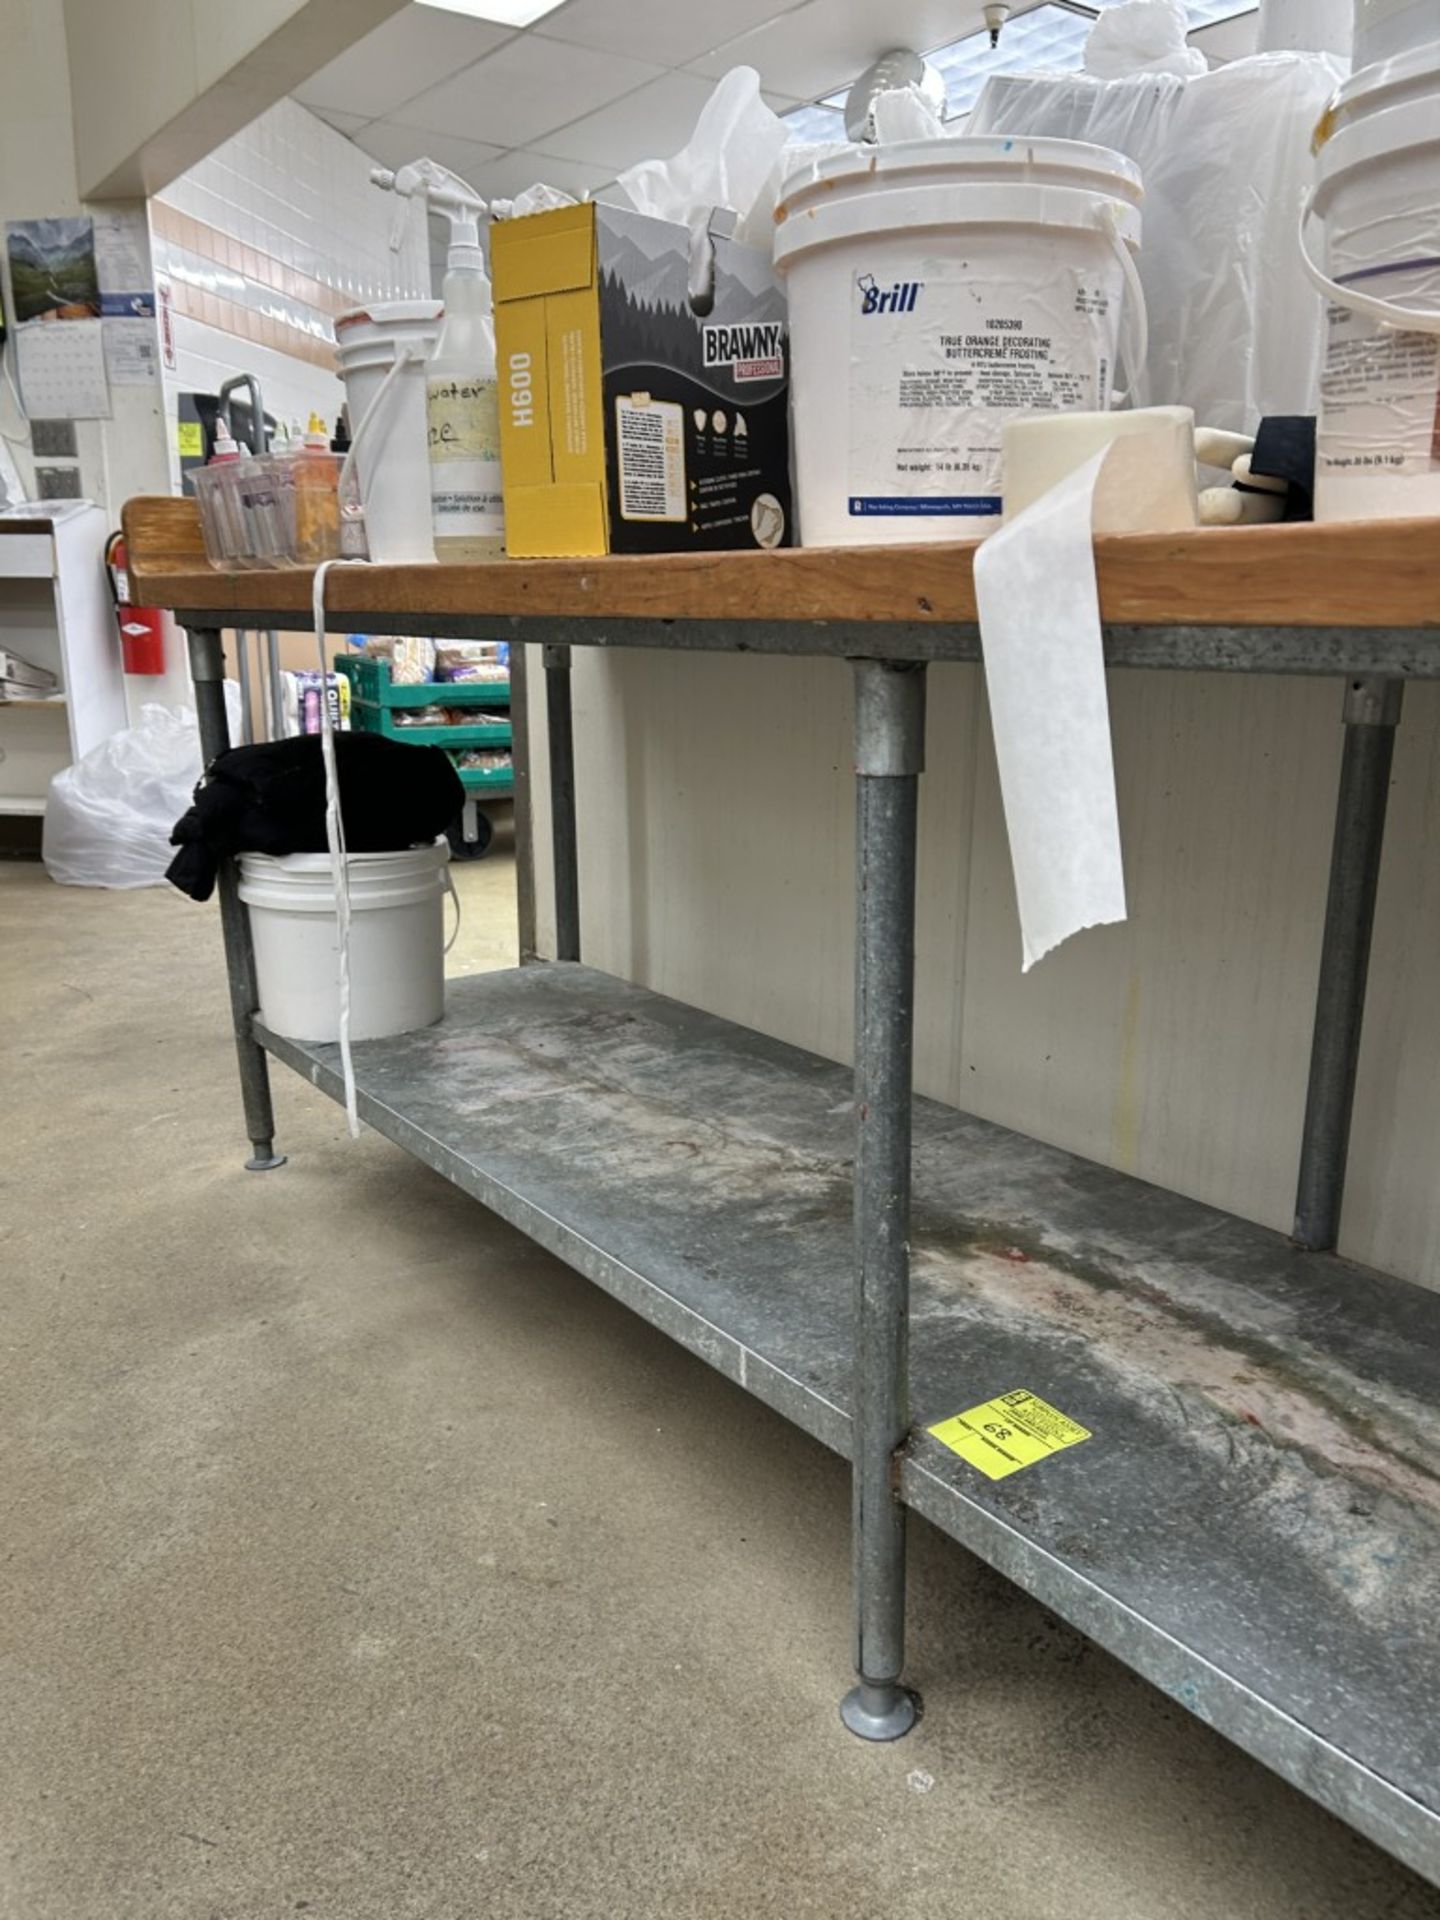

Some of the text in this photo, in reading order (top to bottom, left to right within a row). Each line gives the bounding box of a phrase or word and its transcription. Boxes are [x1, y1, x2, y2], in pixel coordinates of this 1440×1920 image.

[862, 283, 919, 315] Brill
[706, 325, 780, 362] BRAWNY
[940, 336, 1051, 348] TRUE ORANGE DECORATING
[946, 348, 1048, 360] BUTTERCREME FROSTING
[428, 382, 486, 400] water
[509, 352, 533, 427] H600
[983, 1421, 1013, 1441] 68
